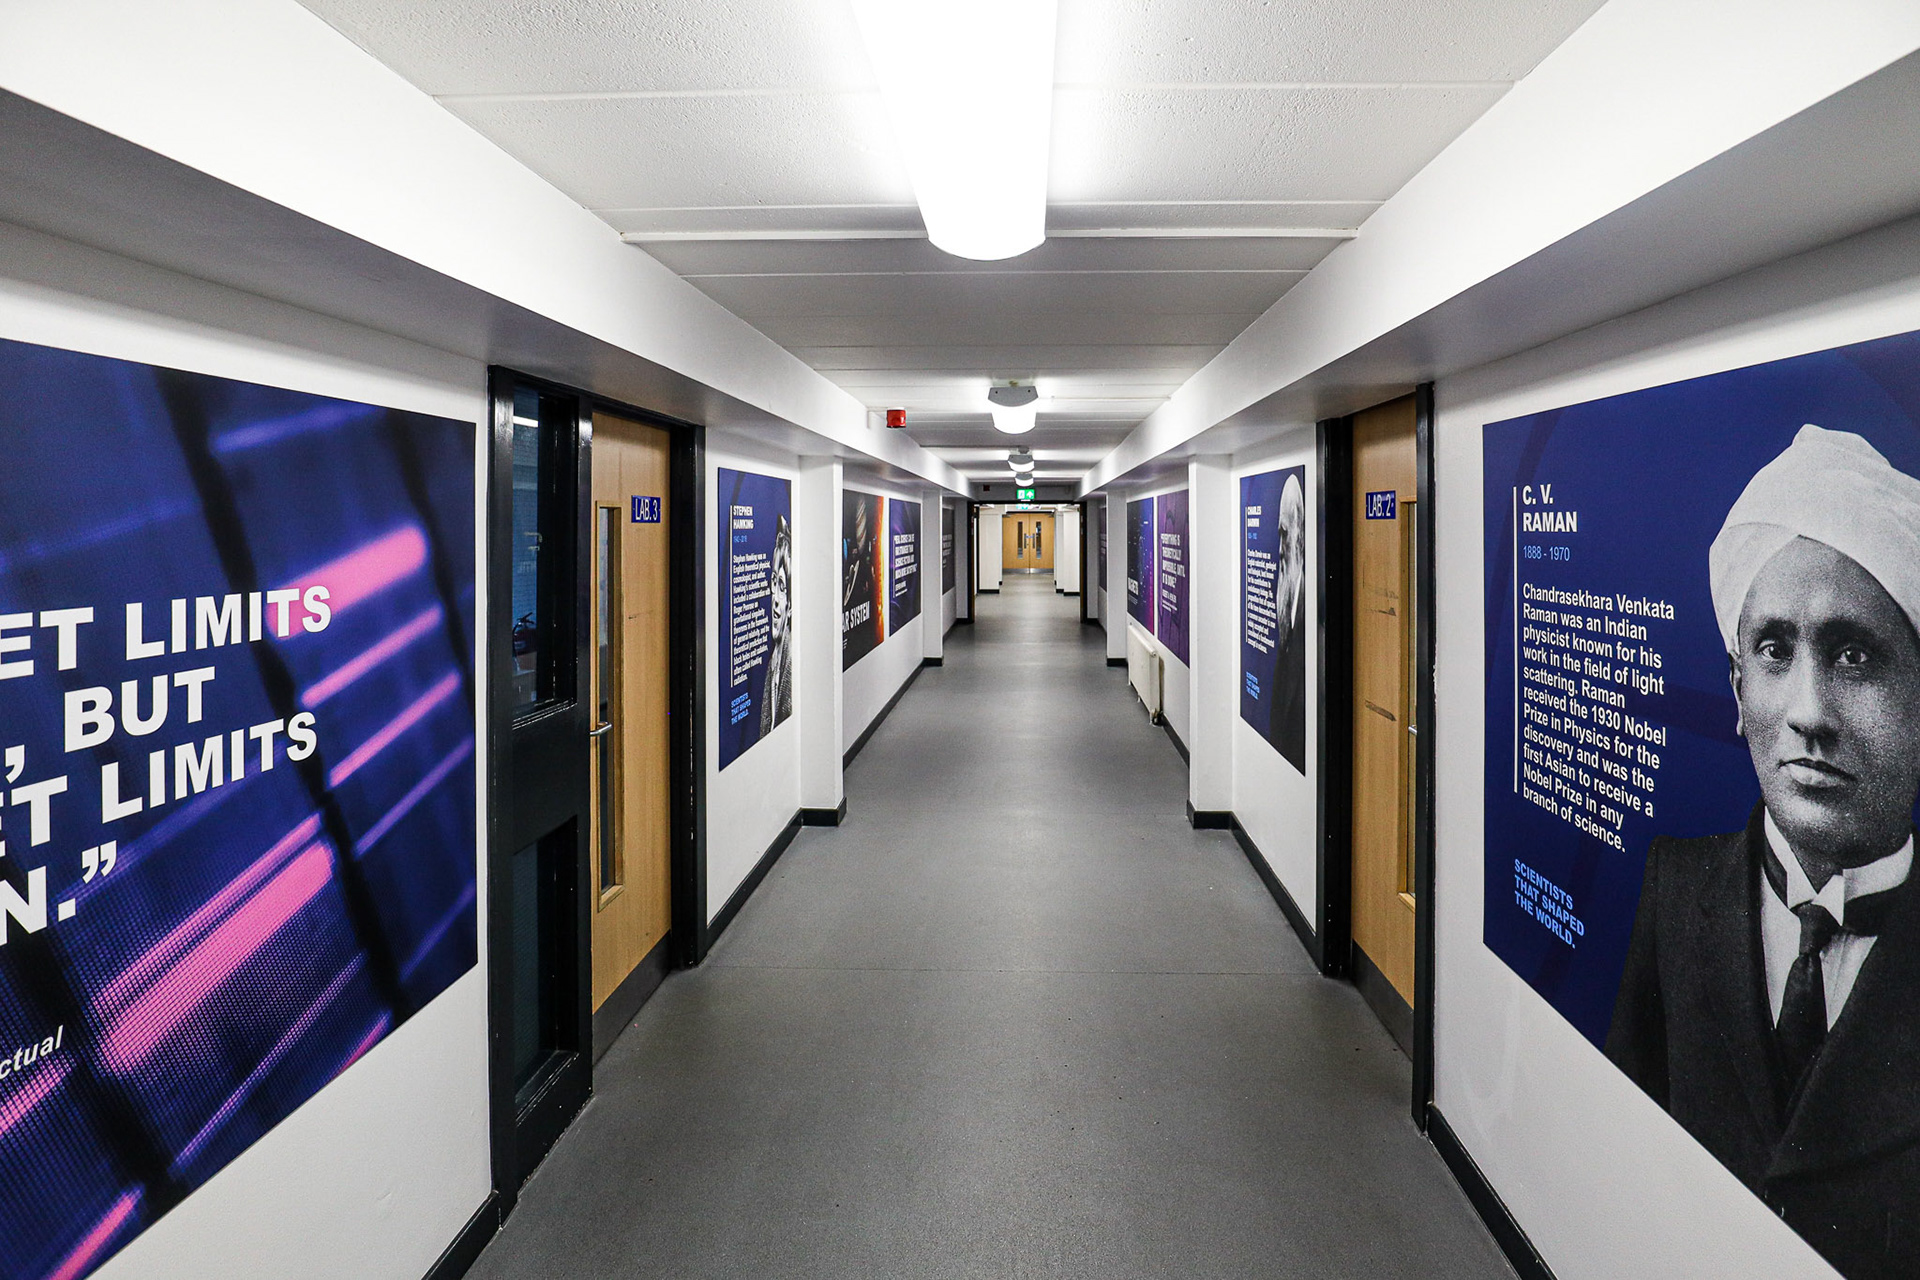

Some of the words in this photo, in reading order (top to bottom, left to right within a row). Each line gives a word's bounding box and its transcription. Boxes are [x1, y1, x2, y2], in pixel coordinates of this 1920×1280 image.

[635, 498, 652, 520] LAB.
[652, 499, 658, 520] 3
[1368, 494, 1384, 516] LAB.
[1385, 493, 1391, 516] 2
[1522, 485, 1537, 505] C.
[1540, 483, 1554, 504] V.
[1522, 511, 1578, 532] RAMAN
[1523, 545, 1542, 560] 1888
[1549, 546, 1571, 561] 1970
[126, 585, 332, 661] LIMITS
[850, 600, 870, 629] SYSTEM
[1522, 582, 1613, 611] Chandrasekhara
[1616, 594, 1675, 620] Venkata
[1523, 603, 1558, 624] Raman
[1560, 613, 1583, 629] was
[1586, 617, 1601, 632] an
[1604, 616, 1647, 641] Indian
[1523, 624, 1570, 648] physicist
[1572, 633, 1613, 658] known
[1616, 641, 1636, 662] for
[1640, 646, 1663, 669] his
[1523, 646, 1547, 664] work
[1550, 649, 1561, 667] in
[1563, 653, 1581, 672] the
[1584, 657, 1611, 681] field
[1614, 666, 1630, 685] of
[1632, 672, 1665, 696] light
[64, 666, 216, 754] BUT
[1523, 665, 1578, 695] scattering.
[1581, 679, 1626, 709] Raman
[1523, 685, 1567, 713] received
[1569, 698, 1588, 719] the
[1591, 705, 1621, 731] 1930
[1625, 717, 1667, 747] Nobel
[1523, 702, 1549, 726] Prize
[1551, 712, 1561, 731] in
[1564, 717, 1611, 750] Physics
[1614, 736, 1634, 759] for
[1637, 745, 1661, 770] the
[102, 711, 318, 824] LIMITS
[1523, 724, 1574, 760] discovery
[1576, 747, 1599, 770] and
[1602, 757, 1628, 782] was
[1631, 765, 1655, 793] the
[1523, 743, 1544, 766] first
[1544, 752, 1576, 781] Asian
[1578, 768, 1592, 787] to
[1593, 778, 1641, 812] receive
[1645, 800, 1654, 818] a
[1523, 762, 1552, 792] Nobel
[1554, 777, 1583, 806] Prize
[1585, 790, 1597, 813] in
[1600, 804, 1624, 831] any
[1523, 782, 1558, 816] branch
[1560, 803, 1573, 823] of
[1574, 812, 1626, 853] science.
[1514, 858, 1574, 910] SCIENTISTS
[1514, 874, 1539, 903] THAT
[1541, 895, 1585, 936] SHAPED
[1514, 890, 1534, 916] THE
[1535, 907, 1576, 949] WORLD.
